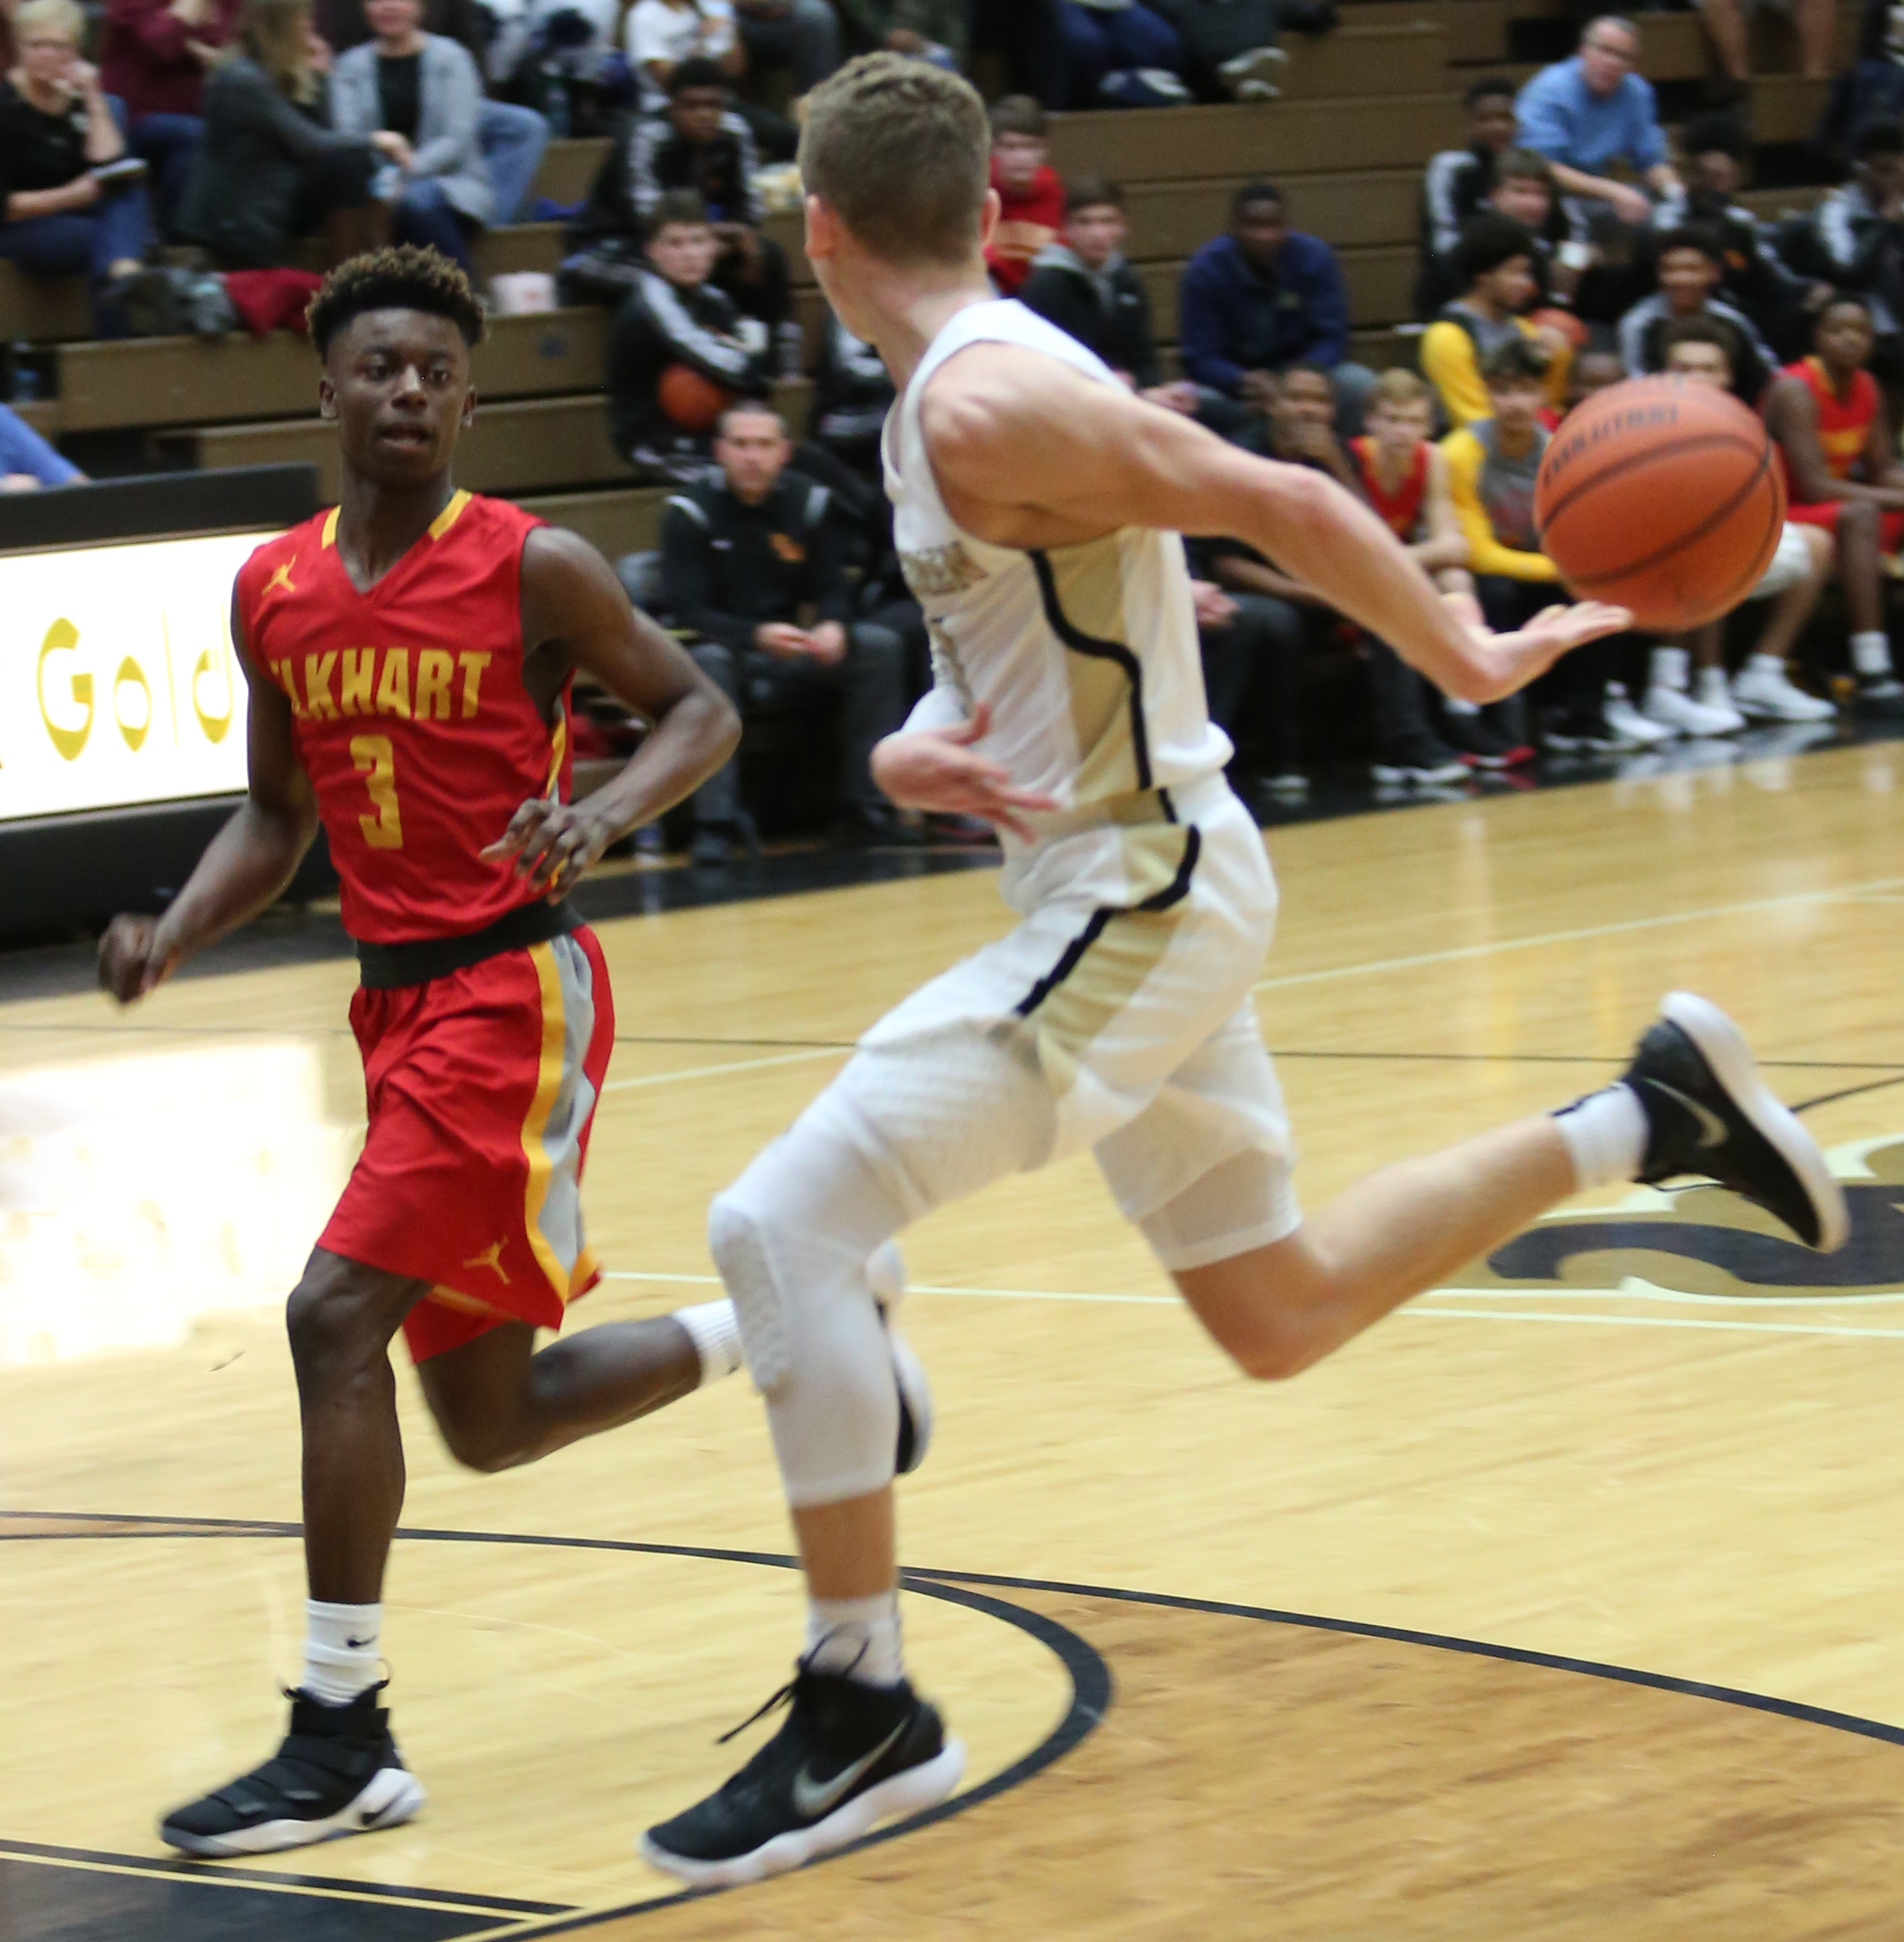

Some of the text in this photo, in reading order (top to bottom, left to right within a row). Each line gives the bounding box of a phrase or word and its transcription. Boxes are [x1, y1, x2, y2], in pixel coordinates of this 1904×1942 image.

[36, 603, 234, 761] Gold
[269, 647, 492, 722] LKHART
[349, 734, 403, 848] 3
